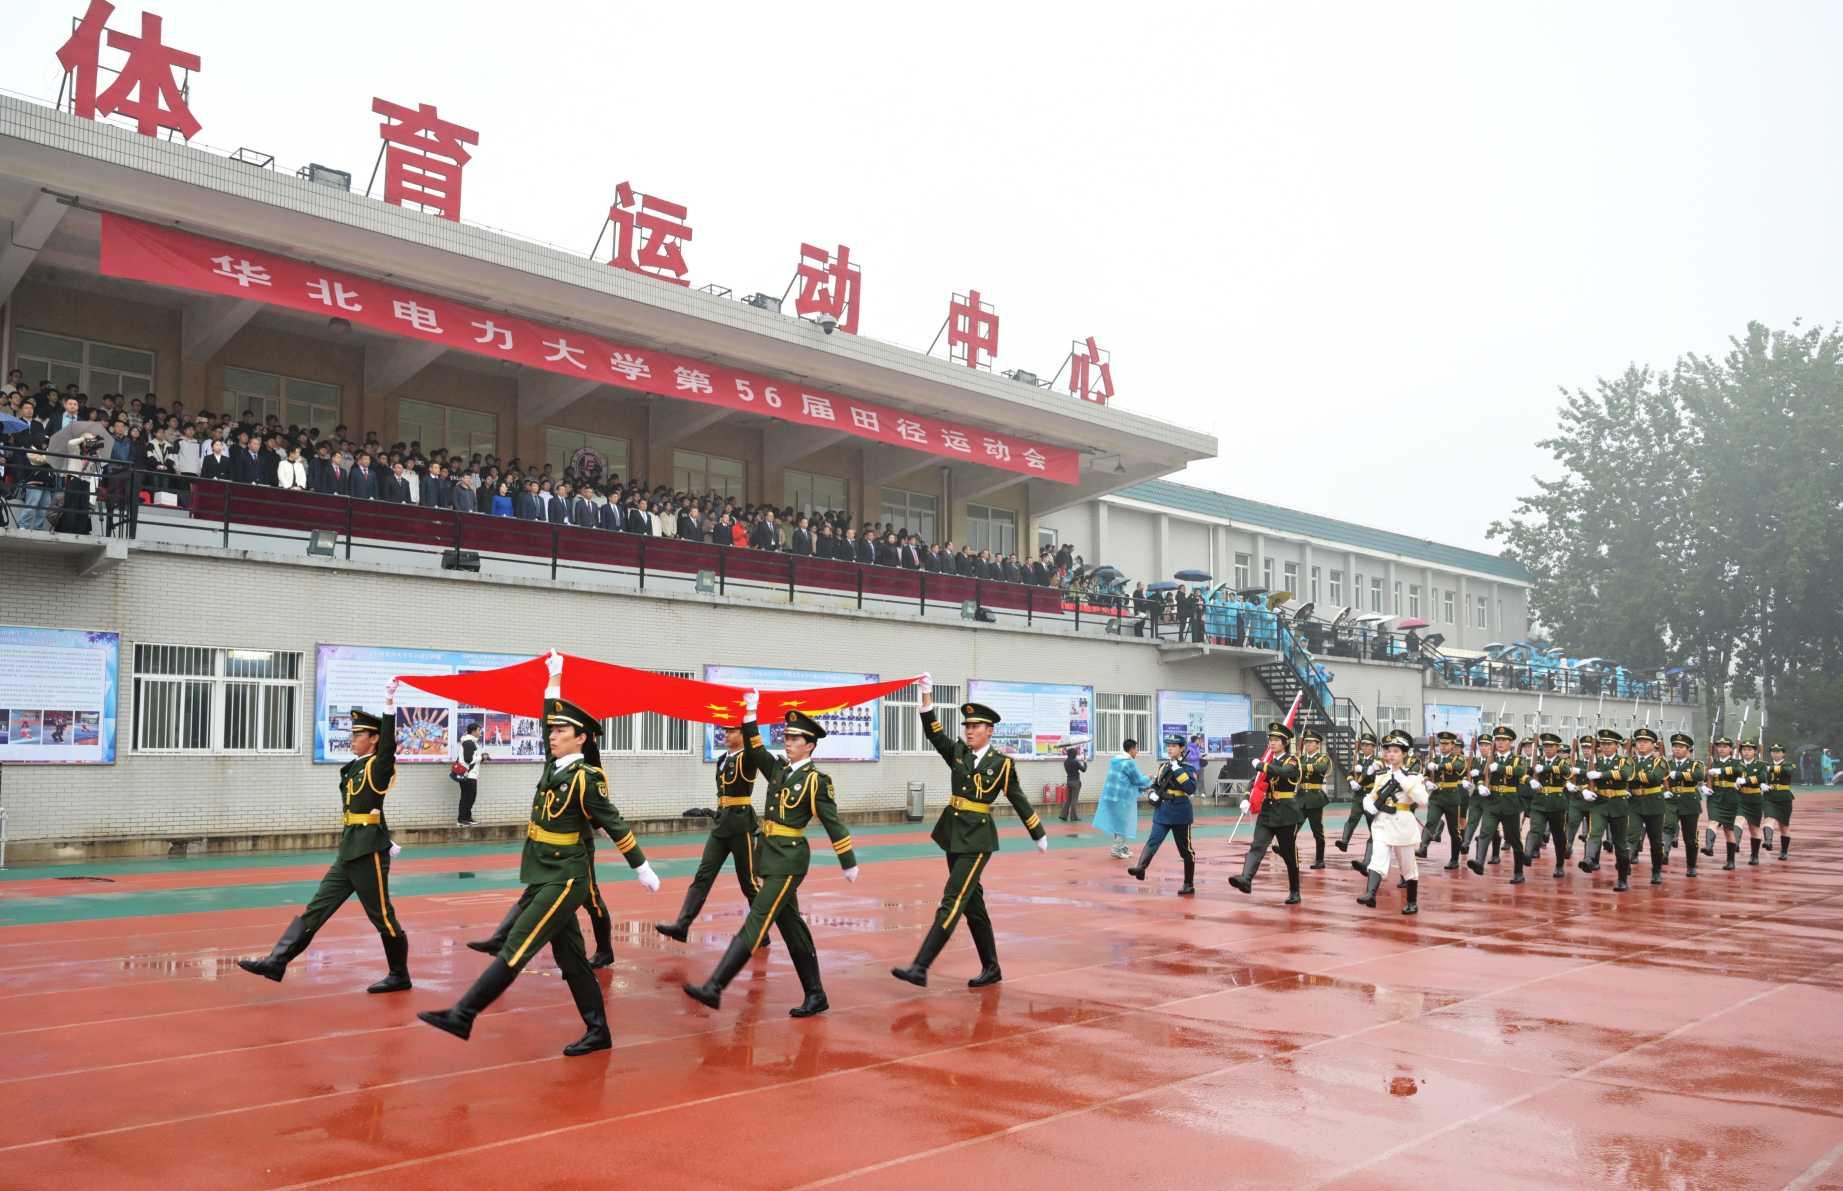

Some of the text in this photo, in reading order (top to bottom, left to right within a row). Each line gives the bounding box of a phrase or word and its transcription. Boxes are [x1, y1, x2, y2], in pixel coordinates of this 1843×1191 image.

[57, 0, 1115, 404] 体育运动中心
[210, 255, 1046, 470] 华北电力大学第56届田径运动会
